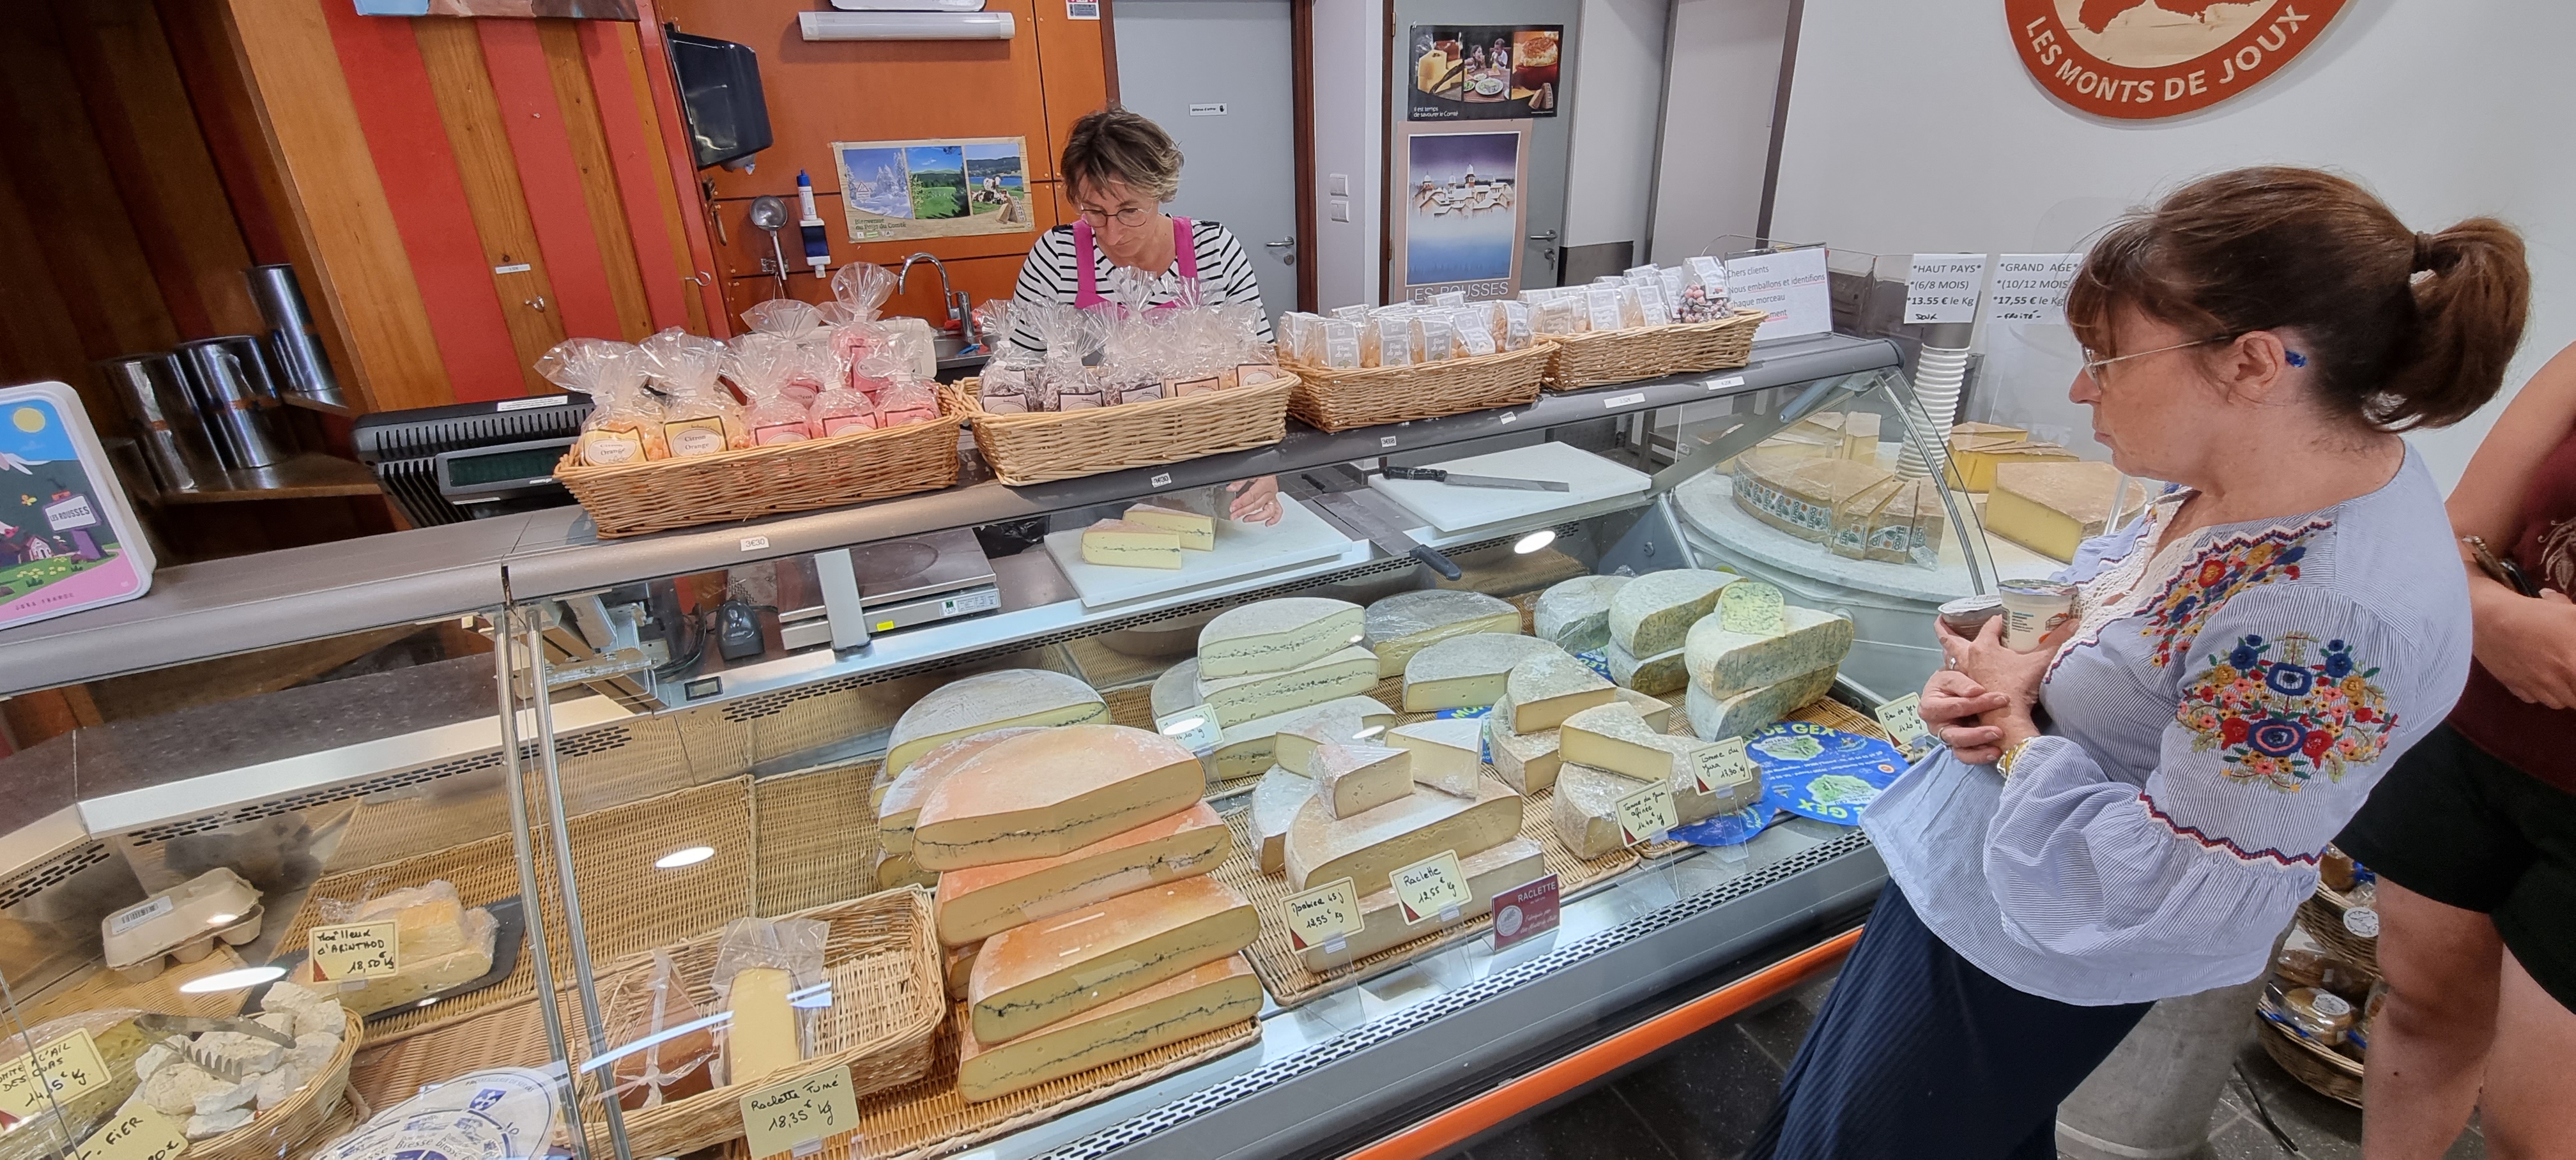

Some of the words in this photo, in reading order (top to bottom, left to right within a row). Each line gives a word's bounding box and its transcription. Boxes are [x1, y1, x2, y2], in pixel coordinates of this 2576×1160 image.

[2026, 16, 2062, 65] LES
[2055, 59, 2154, 103] MONTS
[2164, 70, 2207, 101] DE
[2220, 4, 2310, 84] JOUX
[1747, 266, 1769, 275] clients
[1748, 280, 1781, 291] emballons
[1791, 274, 1825, 285] identifions
[1938, 281, 1968, 290] MOIS)
[1756, 294, 1785, 304] morceau
[1962, 297, 1974, 307] Kg
[2039, 296, 2048, 305] le
[601, 448, 625, 456] Orange
[59, 506, 90, 519] ROUSSES
[746, 538, 765, 547] 3€30
[1791, 724, 1836, 737] GEX
[1728, 746, 1739, 755] du
[1798, 798, 1848, 818] GEX
[1403, 866, 1441, 887] Raclette
[1518, 881, 1556, 903] RACLETTE
[3, 1075, 26, 1092] DES
[751, 1090, 800, 1111] Raclette
[818, 1101, 833, 1126] Kg
